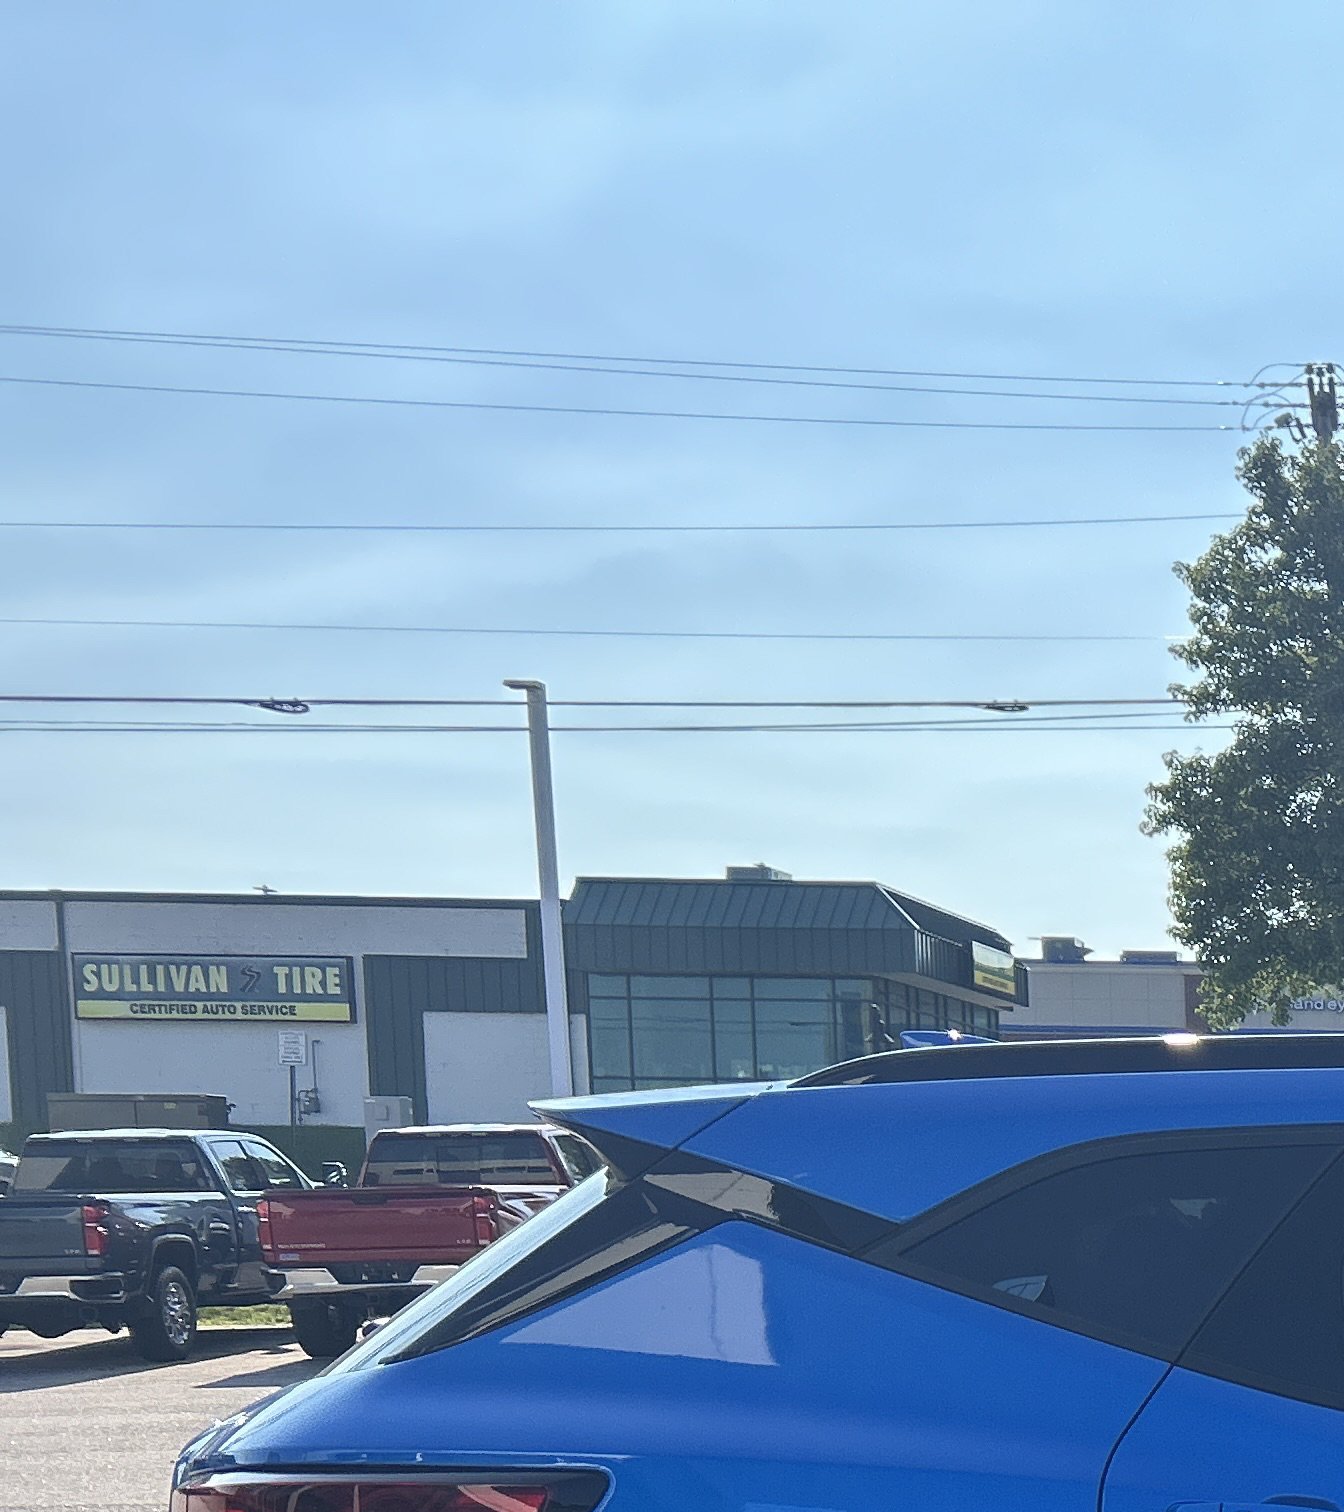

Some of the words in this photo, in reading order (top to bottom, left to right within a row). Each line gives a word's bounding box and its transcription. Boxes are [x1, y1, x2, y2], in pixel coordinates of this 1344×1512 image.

[82, 963, 229, 994] SULLIVAN
[272, 965, 342, 995] TIRE
[129, 1003, 198, 1015] CERTIFIED
[201, 1003, 237, 1015] AUTO
[240, 1004, 297, 1017] SERVICE
